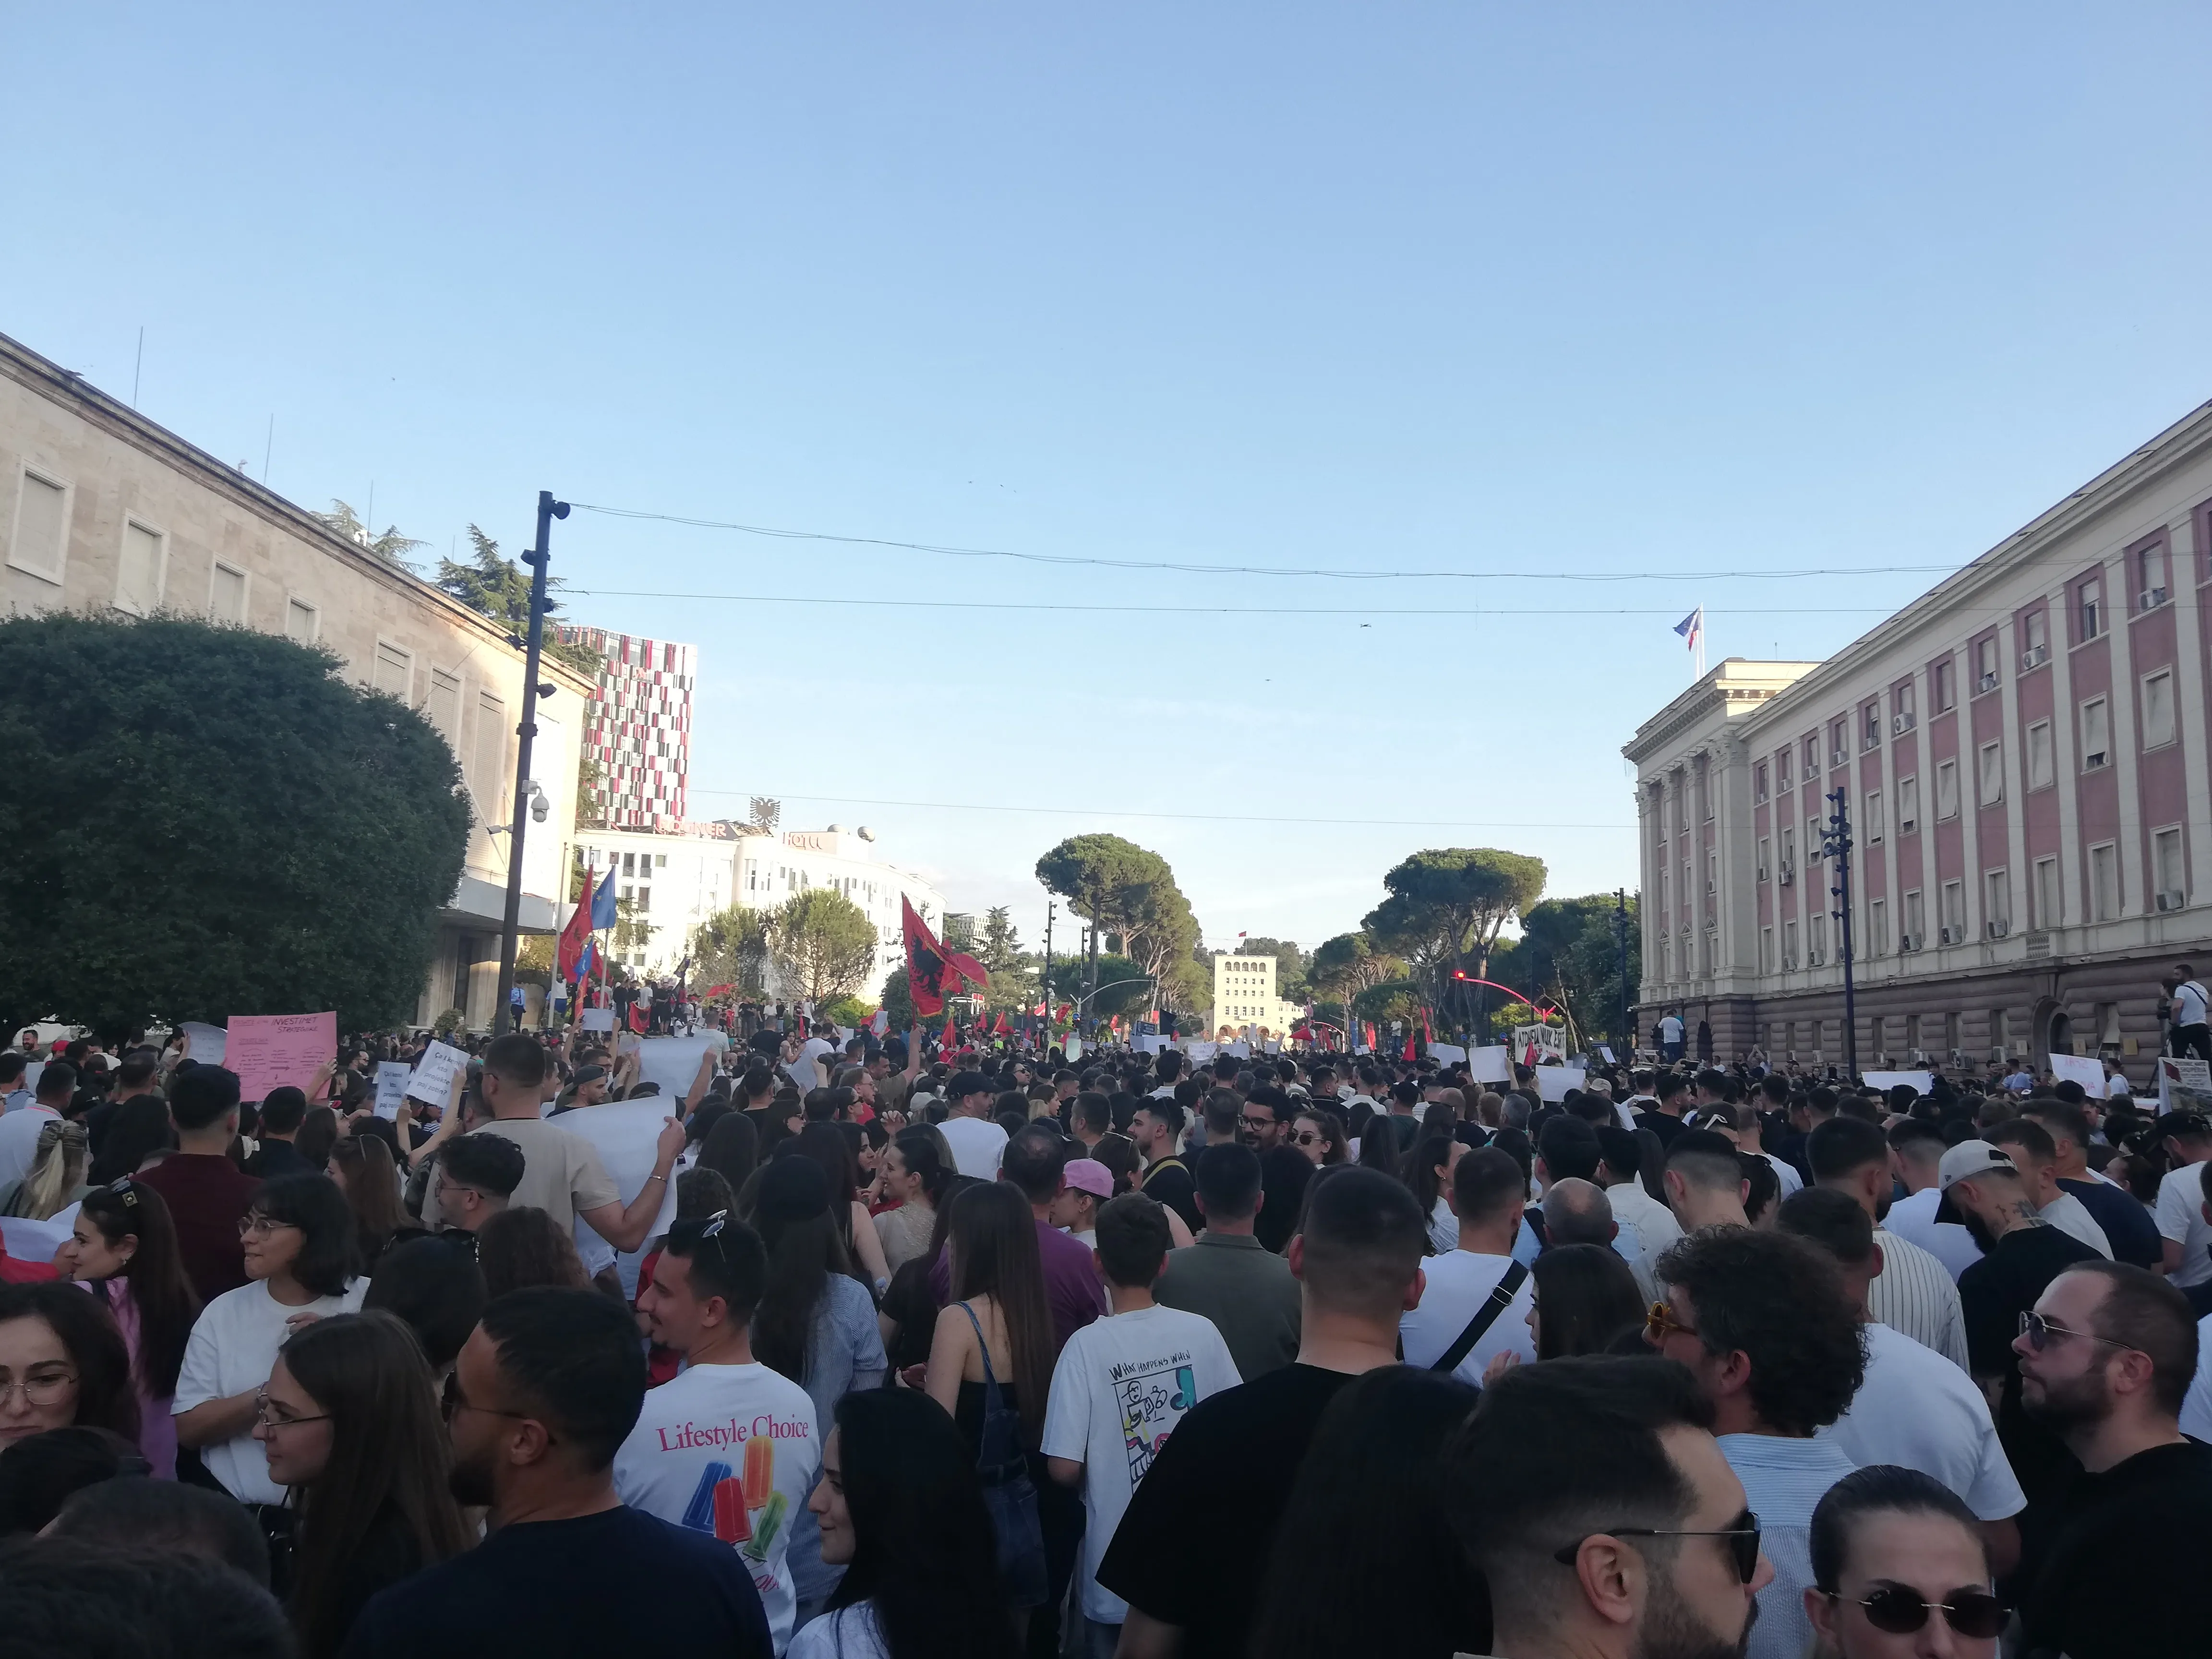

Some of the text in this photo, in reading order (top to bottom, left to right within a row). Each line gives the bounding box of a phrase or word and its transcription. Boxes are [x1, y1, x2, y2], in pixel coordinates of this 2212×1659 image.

[659, 819, 727, 837] ROGNER
[423, 1072, 450, 1085] projekte
[1108, 1349, 1191, 1381] WHAT HAPPENS WHEN
[655, 1414, 809, 1452] Lifestyle Choice
